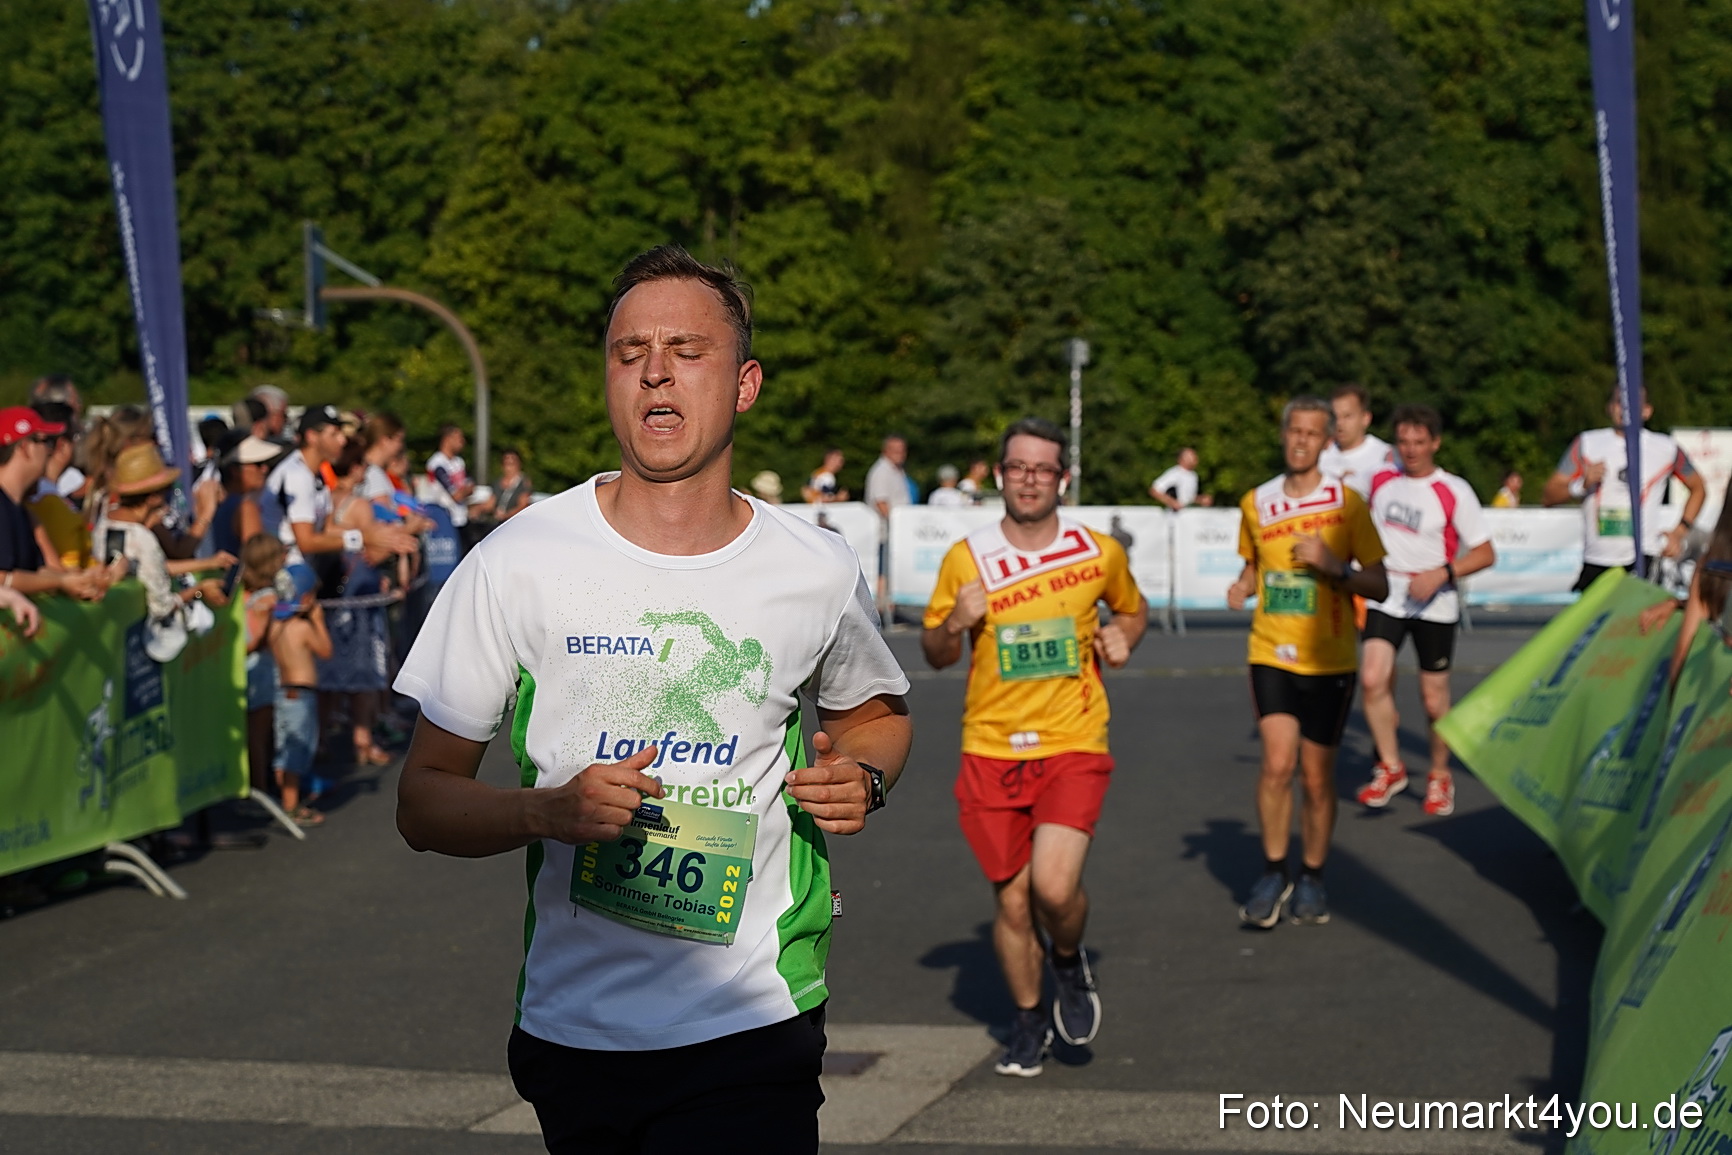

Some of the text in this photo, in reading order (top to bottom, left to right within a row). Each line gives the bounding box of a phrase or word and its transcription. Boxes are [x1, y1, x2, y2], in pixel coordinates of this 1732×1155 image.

[991, 566, 1105, 615] MAX BÖGL
[566, 636, 654, 656] BERATA
[1017, 639, 1059, 662] 818
[629, 818, 681, 835] irmenlauf
[644, 830, 678, 840] neumarkt
[581, 841, 600, 884] RUN
[615, 837, 707, 894] 346
[594, 874, 659, 905] Sommer
[663, 893, 716, 916] Tobias
[616, 901, 639, 913] BERATA
[639, 907, 657, 917] GmbH
[716, 865, 741, 924] 2022
